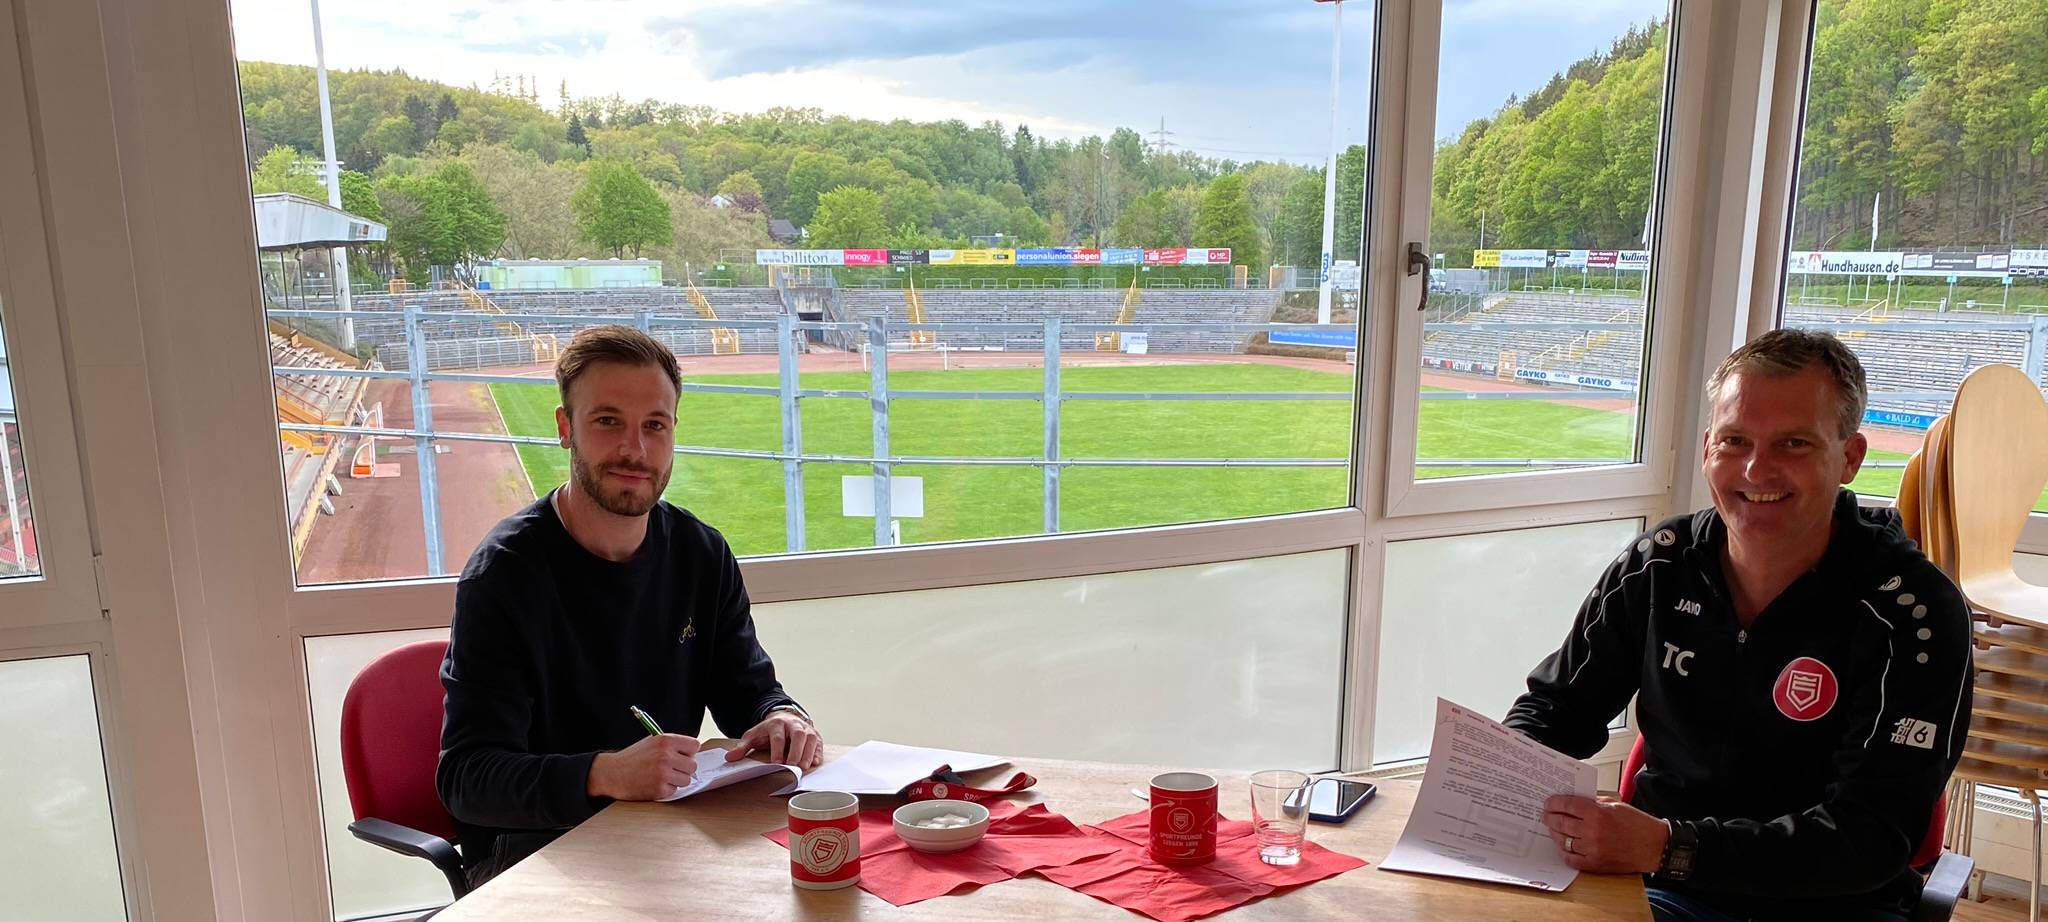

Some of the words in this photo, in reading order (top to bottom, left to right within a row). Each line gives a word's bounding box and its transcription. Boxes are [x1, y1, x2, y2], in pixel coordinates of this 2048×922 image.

[845, 252, 871, 262] innogy
[1821, 260, 1899, 273] Hundhausen.de
[1516, 369, 1547, 379] GAYKO
[1577, 376, 1612, 387] GAYKO
[1662, 641, 1696, 677] TC
